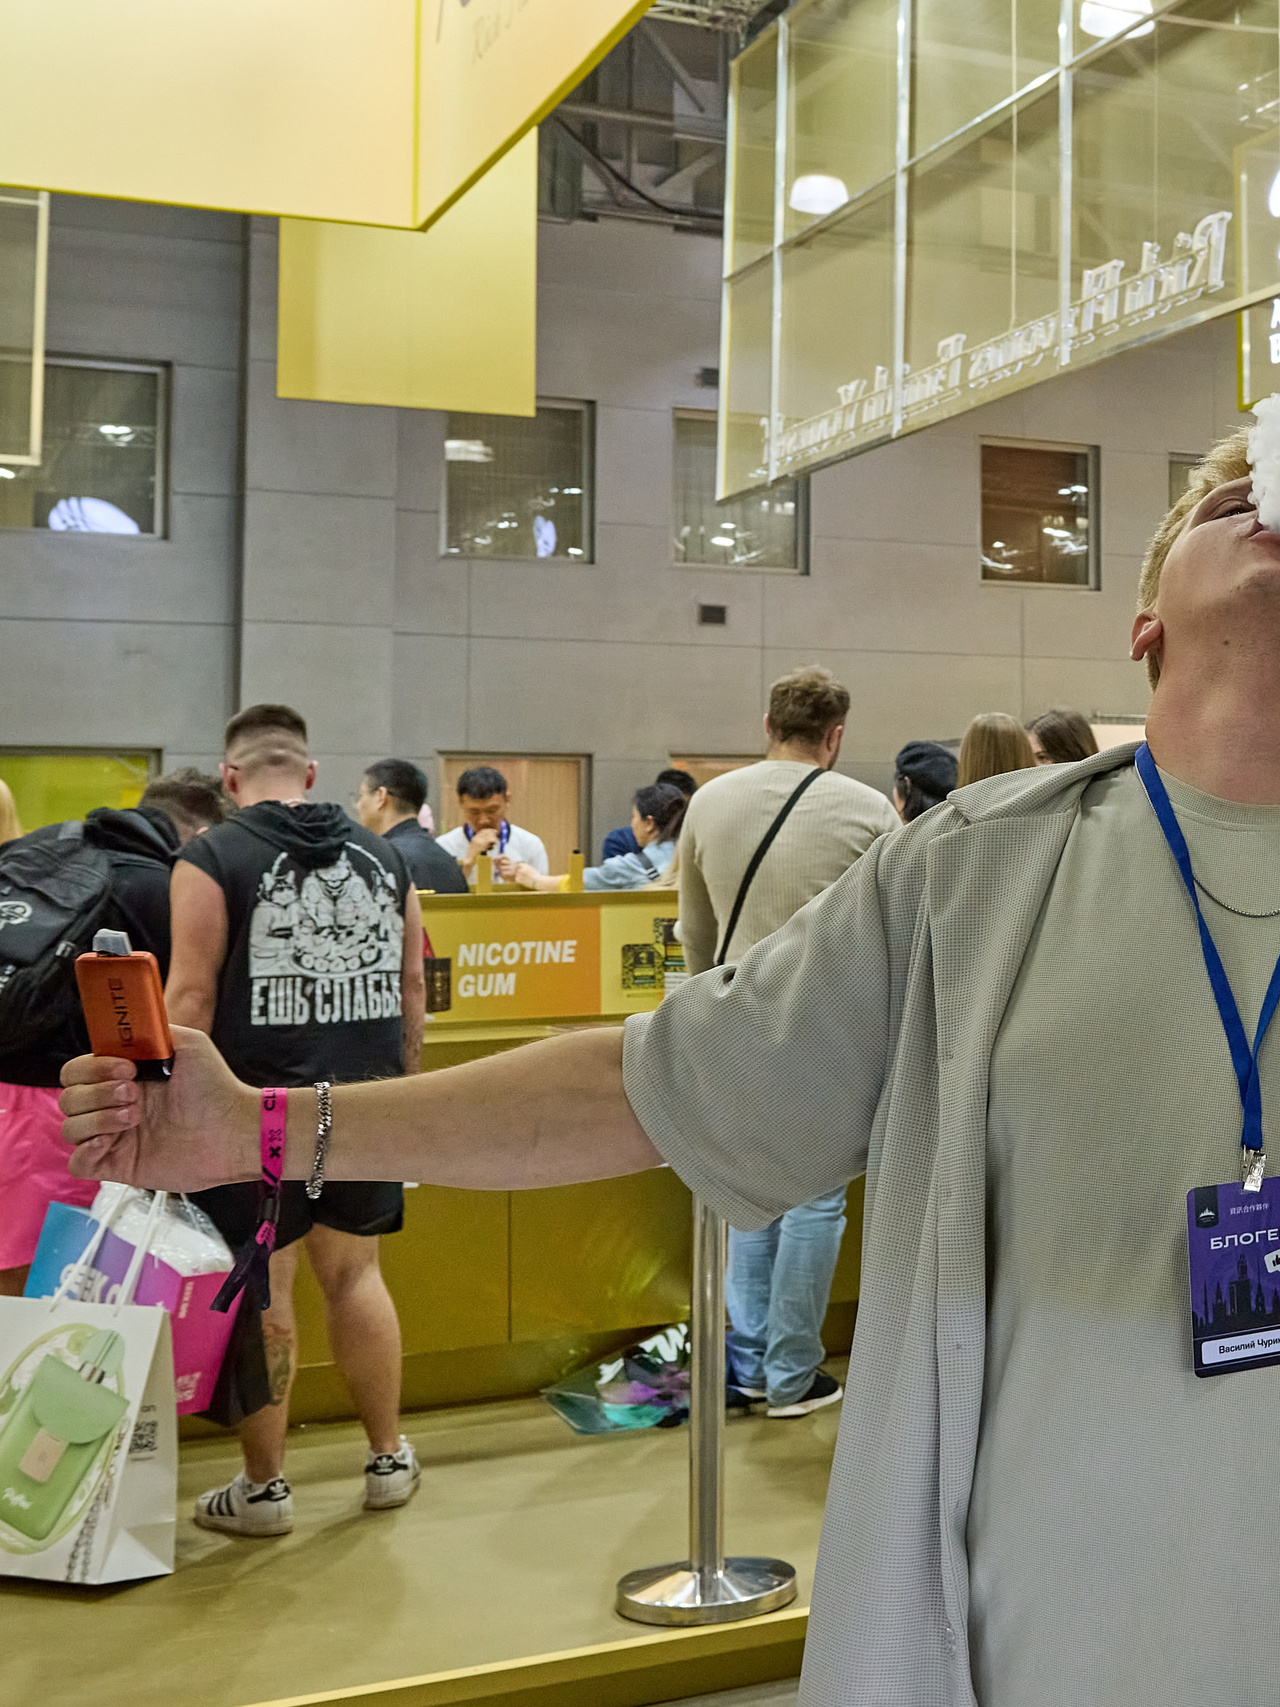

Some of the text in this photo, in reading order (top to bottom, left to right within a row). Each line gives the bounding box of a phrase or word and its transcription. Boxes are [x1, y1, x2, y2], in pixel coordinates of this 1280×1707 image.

[458, 940, 577, 967] NICOTINE
[457, 972, 516, 998] GUM
[108, 977, 135, 1048] IGNITE
[1218, 1340, 1256, 1354] Василий
